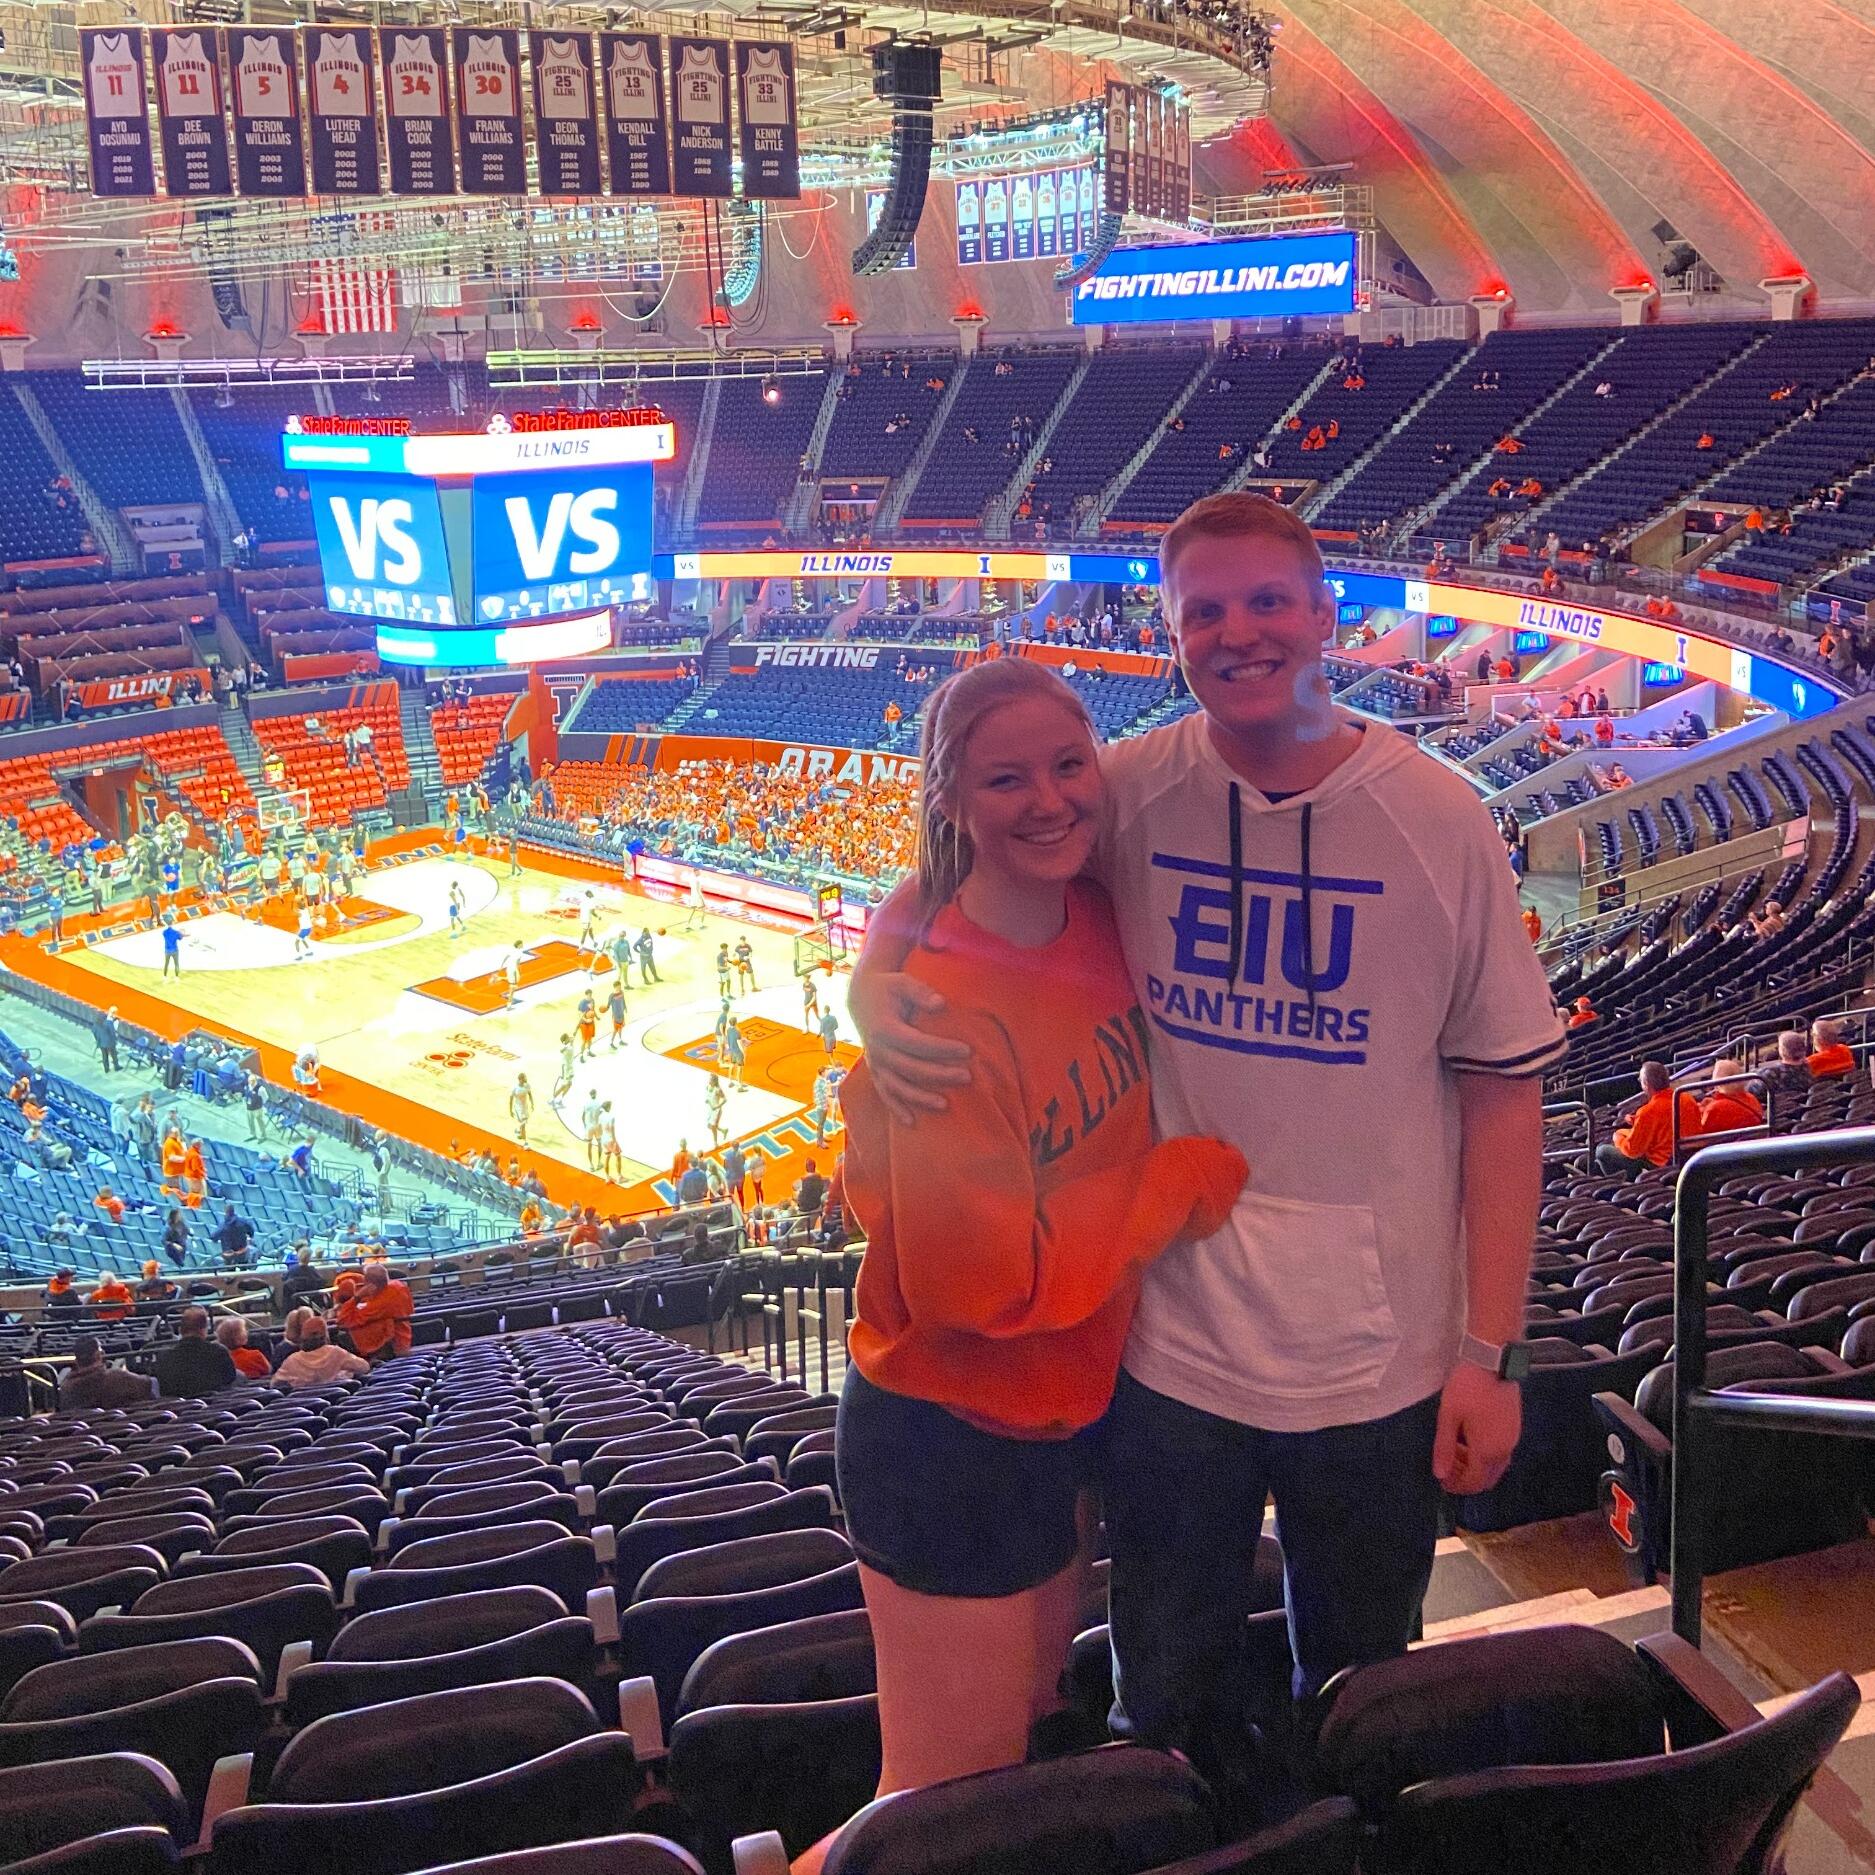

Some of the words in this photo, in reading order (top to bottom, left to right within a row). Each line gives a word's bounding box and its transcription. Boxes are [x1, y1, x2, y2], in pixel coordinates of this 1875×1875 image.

[168, 60, 206, 74] ILLINOIS
[244, 62, 282, 75] ILLINOIS
[320, 60, 359, 73] ILLINOIS
[395, 61, 433, 74] ILLINOIS
[469, 62, 506, 74] ILLINOIS
[544, 65, 581, 77] FIGHTING
[615, 66, 651, 79] FIGHTING
[178, 74, 200, 95] 11
[333, 74, 350, 94] 4
[555, 75, 572, 87] 25
[683, 72, 717, 84] FIGHTING
[749, 74, 782, 86] FIGHTING
[107, 75, 123, 95] 11
[258, 75, 271, 96] 5
[400, 75, 431, 95] 34
[474, 75, 502, 95] 30
[692, 81, 708, 93] 25
[758, 83, 773, 95] 33
[111, 121, 127, 132] AYO
[184, 120, 202, 132] DEE
[252, 120, 284, 133] DERON
[325, 118, 361, 132] LUTHER
[404, 119, 433, 132] BRIAN
[475, 119, 506, 132] FRANK
[555, 122, 579, 134] DEON
[618, 122, 656, 135] KENDALL
[691, 125, 711, 137] NICK
[99, 132, 141, 146] DOSUNMU
[178, 132, 211, 145] BROWN
[245, 132, 292, 145] WILLIAMS
[331, 131, 357, 144] HEAD
[407, 132, 432, 145] COOK
[469, 132, 514, 144] WILLIAMS
[549, 134, 586, 146] THOMAS
[628, 134, 647, 146] GILL
[755, 128, 782, 140] KENNY
[680, 136, 723, 150] ANDERSON
[754, 139, 783, 151] BATTLE
[1078, 261, 1350, 300] FIGHTINGILLINI.COM
[599, 410, 661, 427] CENTER
[361, 419, 409, 436] CENTER
[517, 440, 590, 457] ILLINOIS
[328, 495, 422, 585] VS
[504, 488, 620, 580] VS
[679, 562, 694, 570] VS
[800, 555, 892, 572] ILLINOIS
[1052, 563, 1065, 572] VS
[1411, 592, 1423, 602] VS
[1519, 603, 1602, 639] ILLINOIS
[755, 644, 880, 668] FIGHTING
[108, 676, 173, 700] ILLINI
[778, 748, 921, 786] ORANG
[1168, 884, 1354, 993] EIU
[1147, 974, 1371, 1044] PANTHERS
